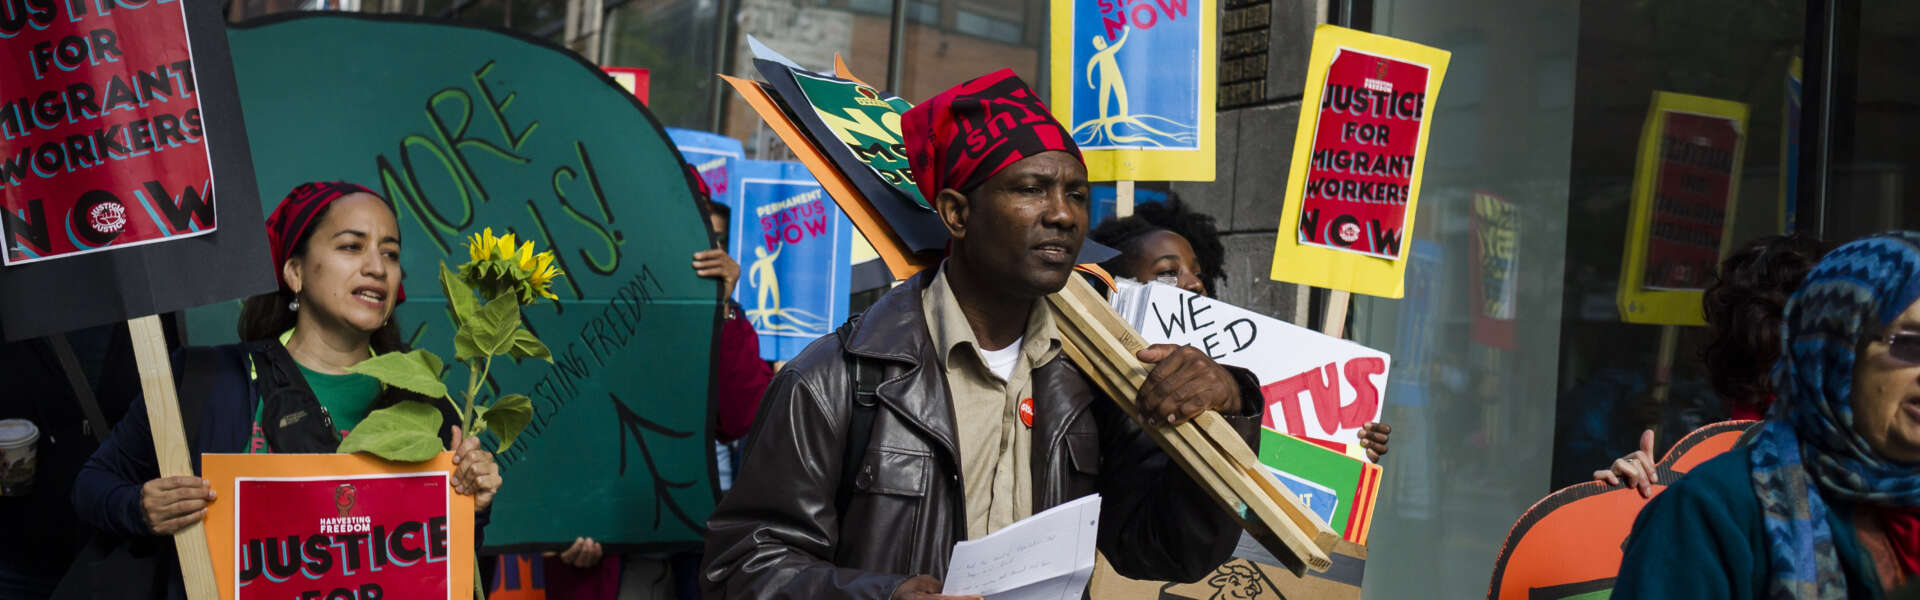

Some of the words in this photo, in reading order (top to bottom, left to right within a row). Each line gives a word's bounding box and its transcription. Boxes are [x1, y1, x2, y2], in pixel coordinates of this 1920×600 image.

[1102, 0, 1188, 41] NOW
[30, 28, 123, 79] FOR
[1322, 84, 1425, 121] JUSTICE
[1342, 121, 1390, 146] FOR
[1311, 149, 1414, 178] MIGRANT
[756, 189, 822, 218] PERMANENT
[1304, 178, 1409, 206] WORKERS
[760, 200, 825, 231] STATUS
[763, 215, 827, 252] NOW
[1300, 208, 1402, 257] NOW
[581, 264, 665, 368] FREEDOM
[1152, 293, 1215, 339] WE
[1184, 318, 1258, 360] ED
[1260, 356, 1386, 438] TUS
[320, 516, 371, 525] HARVESTING
[320, 523, 371, 534] FREEDOM
[239, 516, 447, 587] JUSTICE
